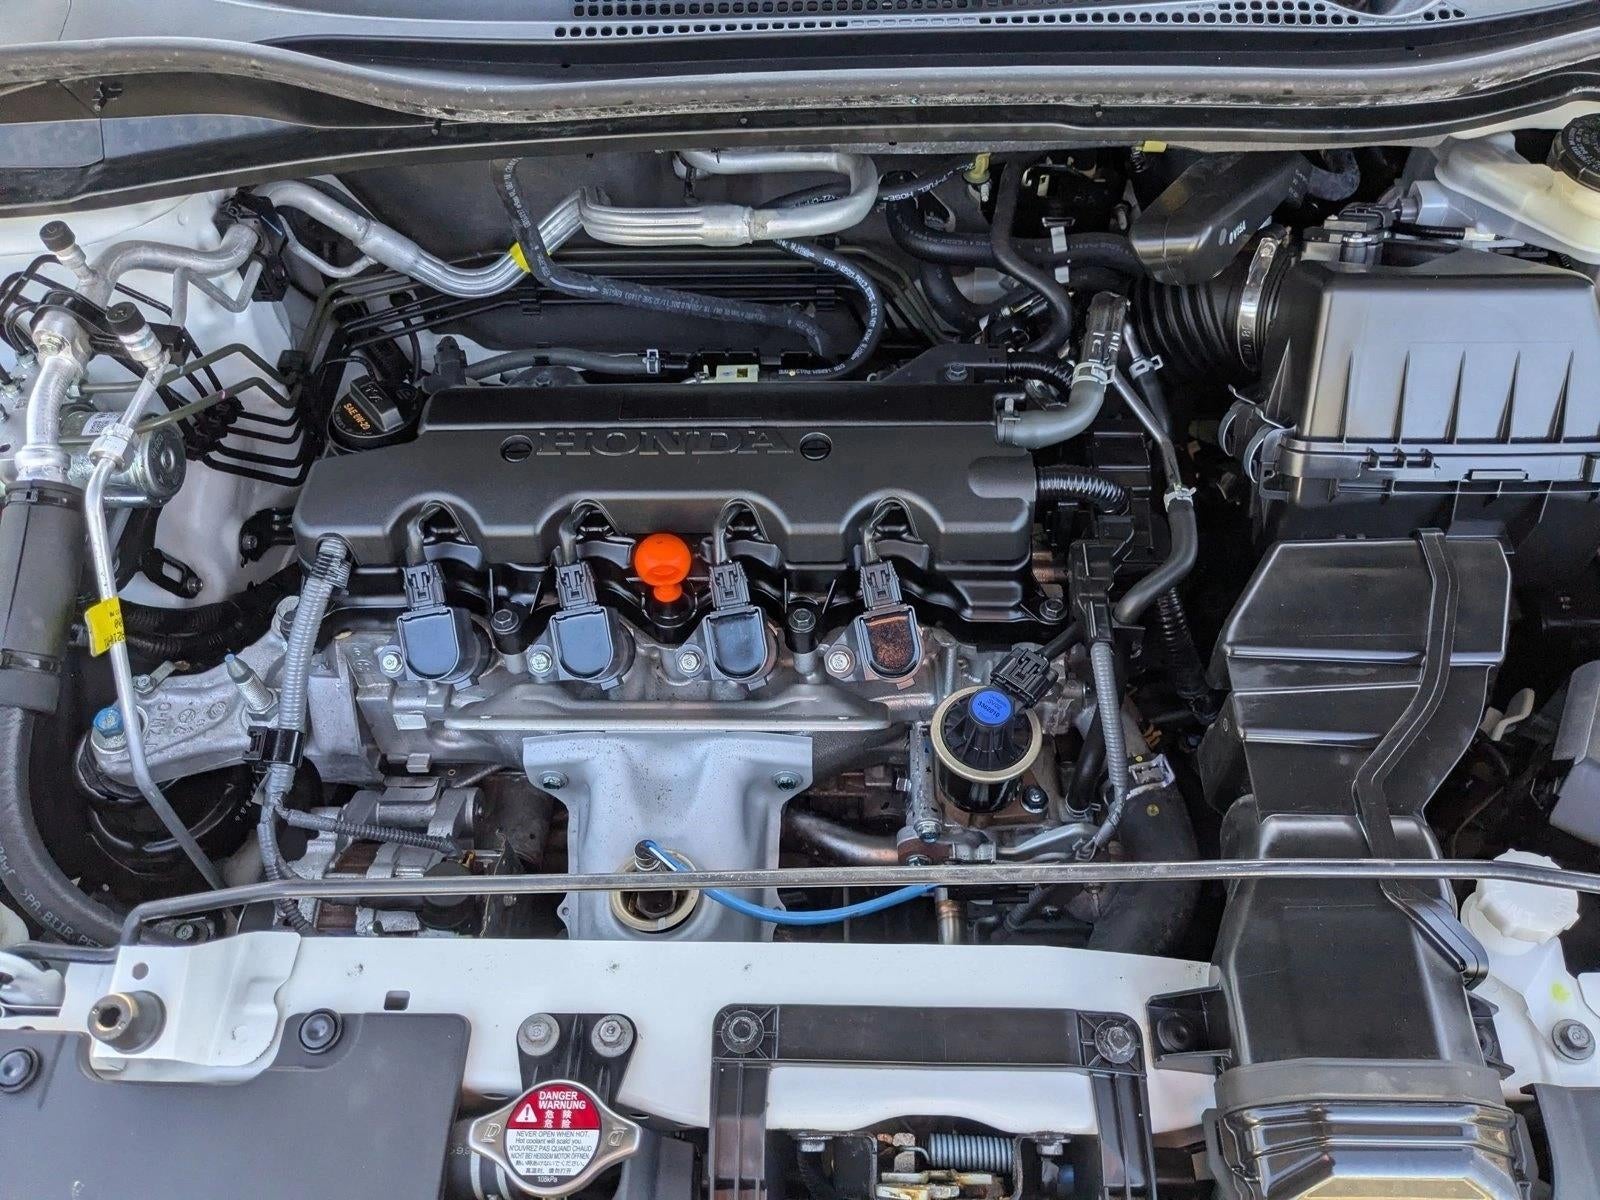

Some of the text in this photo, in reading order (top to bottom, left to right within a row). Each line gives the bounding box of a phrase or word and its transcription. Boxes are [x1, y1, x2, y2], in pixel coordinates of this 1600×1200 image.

[343, 402, 358, 416] SAE
[536, 431, 795, 456] HONDA
[538, 1091, 578, 1100] DANGER
[538, 1100, 586, 1109] WARNUNG
